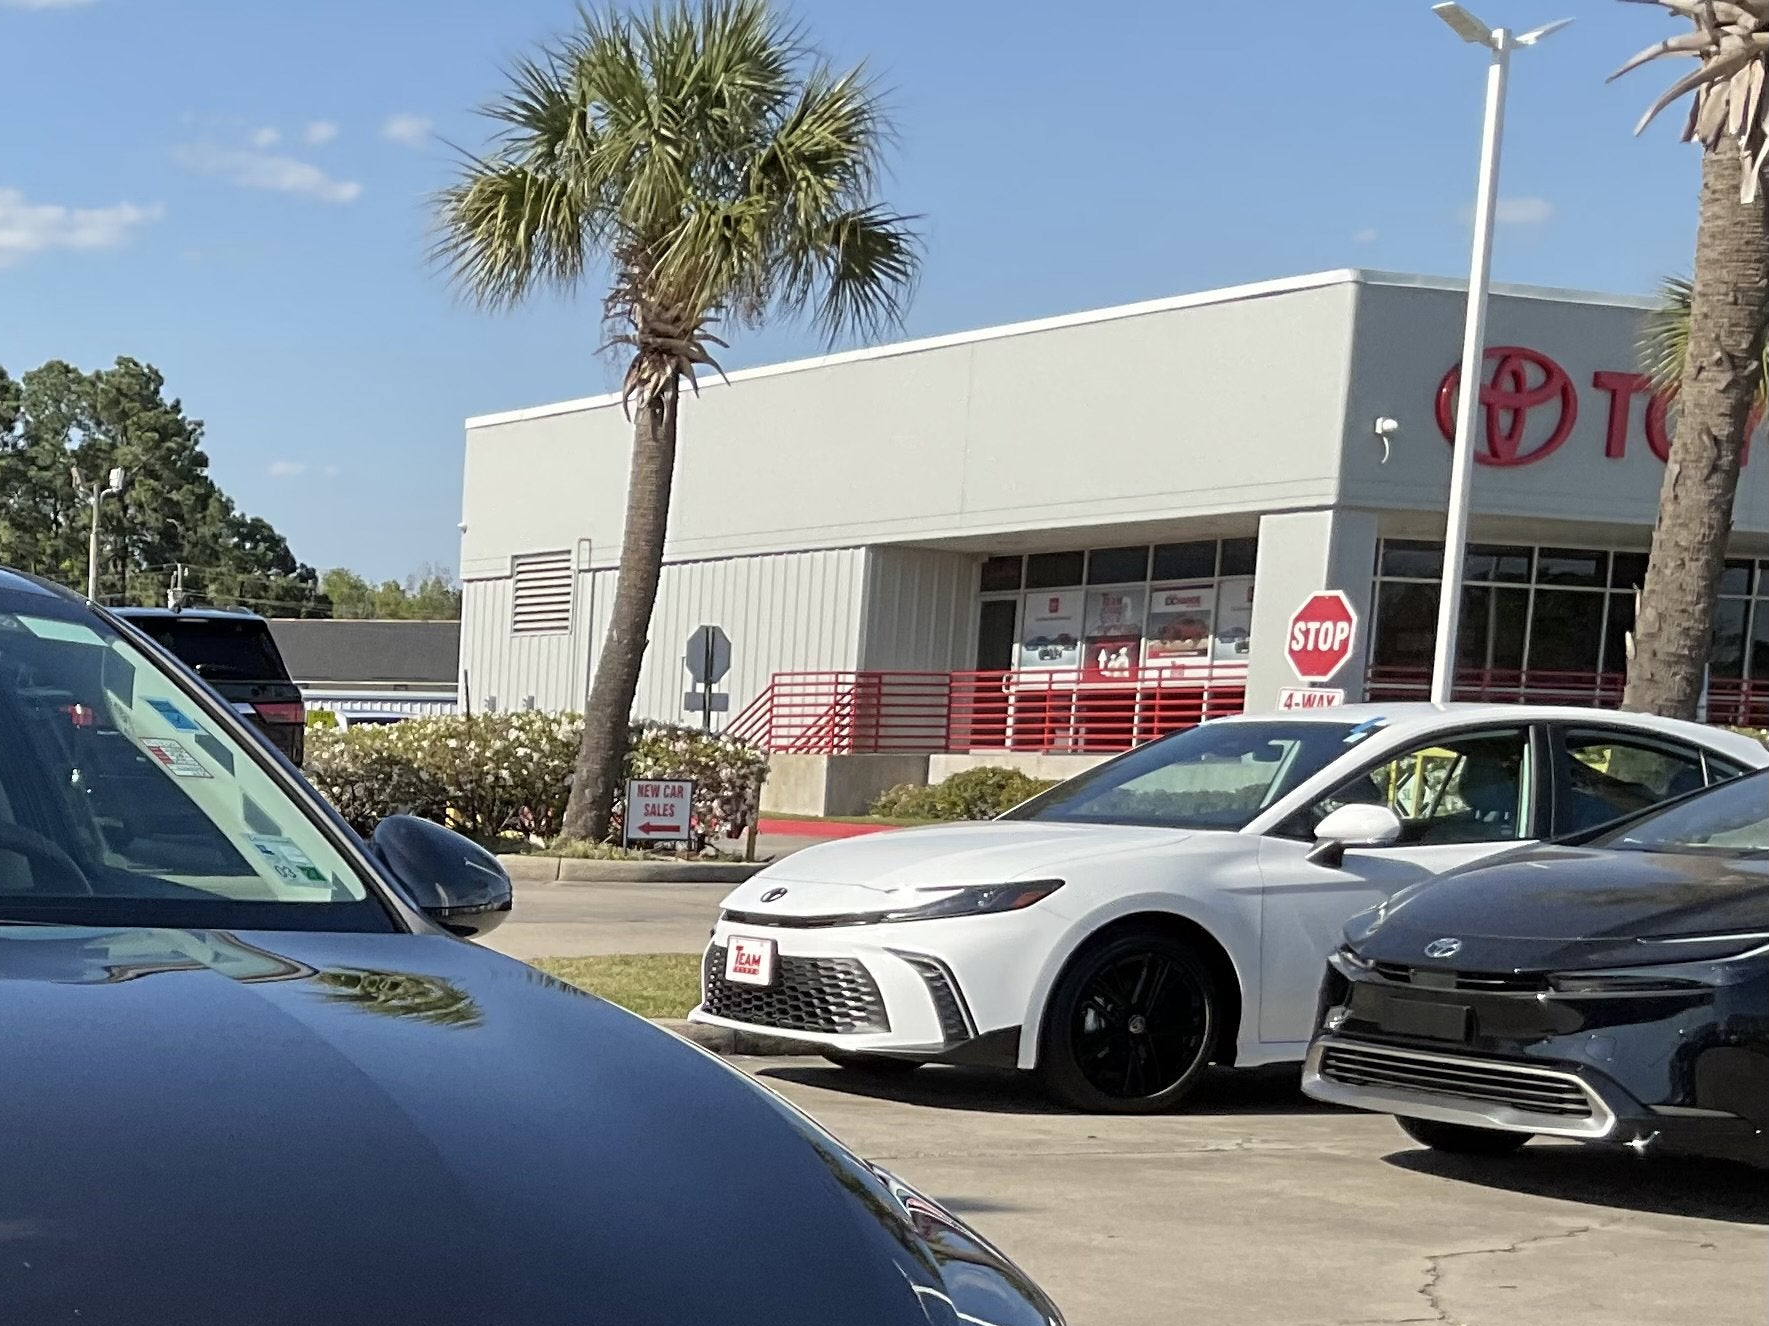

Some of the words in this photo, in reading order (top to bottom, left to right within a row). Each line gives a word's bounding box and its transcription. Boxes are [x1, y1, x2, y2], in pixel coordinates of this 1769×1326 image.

[1291, 620, 1350, 652] STOP
[1283, 692, 1336, 710] 4-WAY
[637, 783, 660, 798] NEW
[663, 784, 684, 799] CAR
[643, 803, 676, 817] SALES
[735, 944, 762, 966] TEAM
